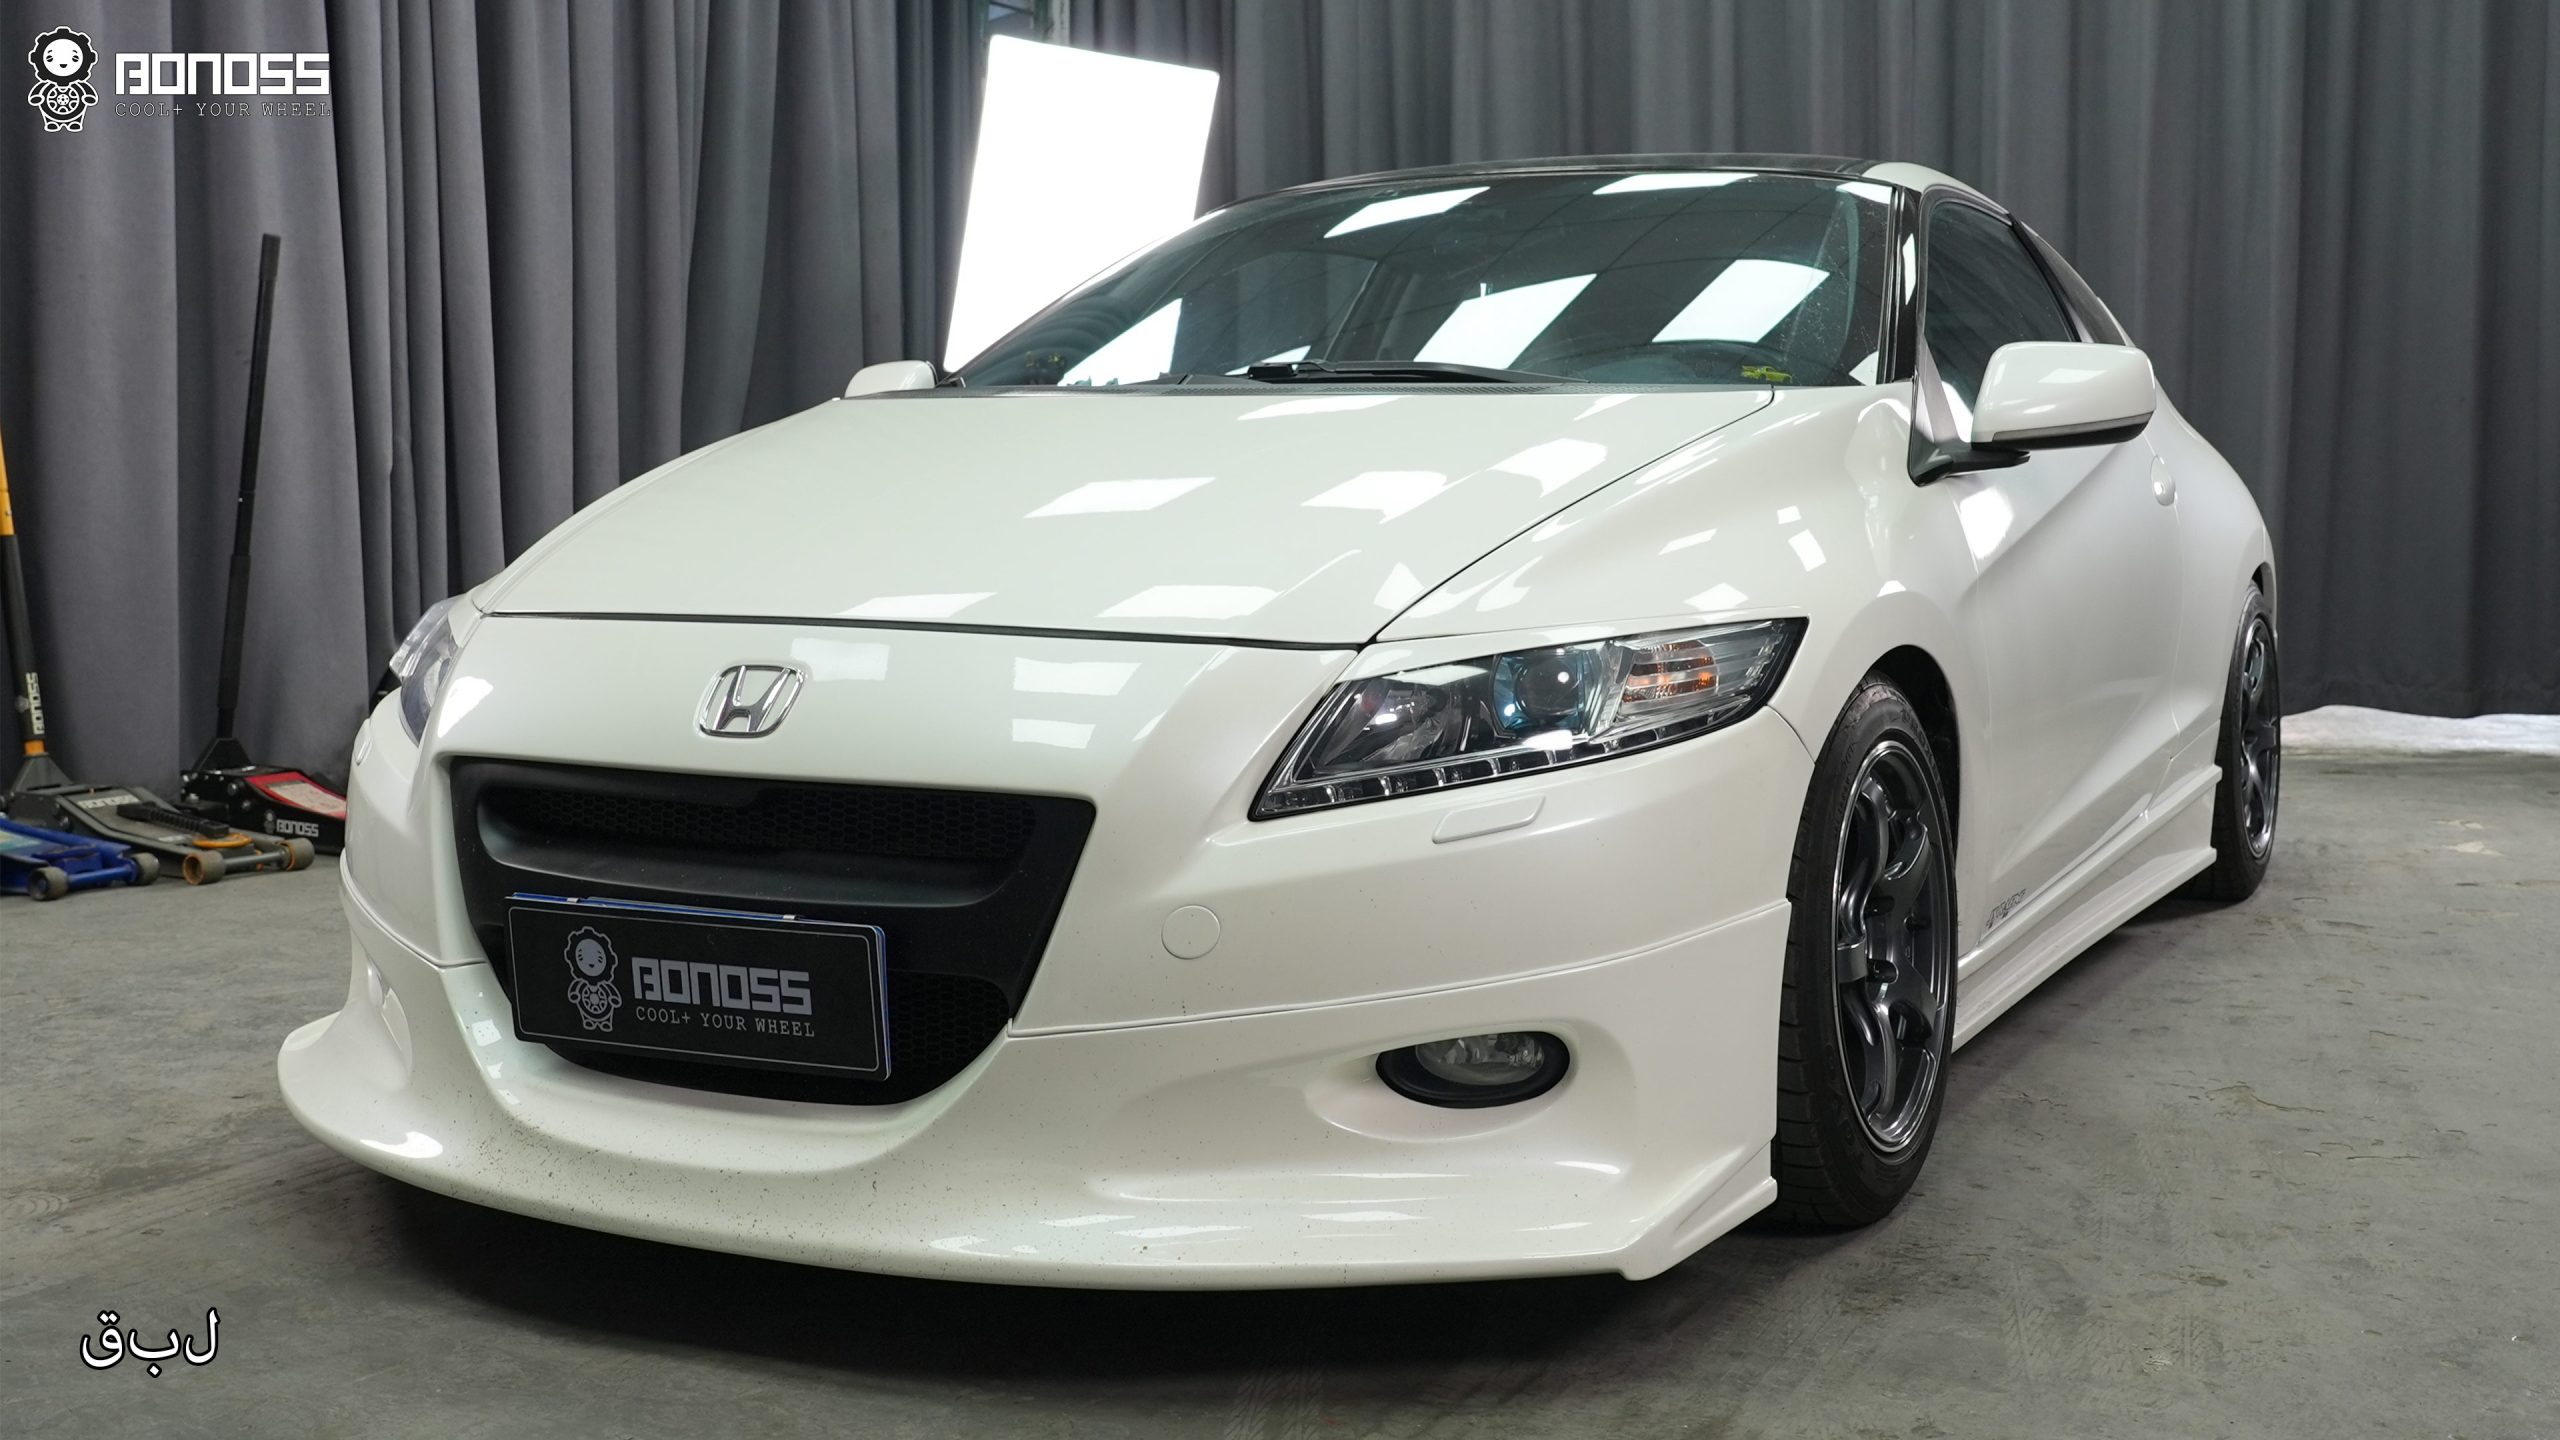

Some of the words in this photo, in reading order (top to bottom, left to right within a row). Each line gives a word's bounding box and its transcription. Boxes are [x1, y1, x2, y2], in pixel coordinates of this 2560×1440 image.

[26, 671, 45, 734] BONOSS
[276, 818, 319, 837] BONOSS
[631, 957, 812, 1015] BONOSS
[635, 1006, 690, 1024] COOL+
[700, 1012, 747, 1031] YOUR
[755, 1018, 815, 1037] WHEEL
